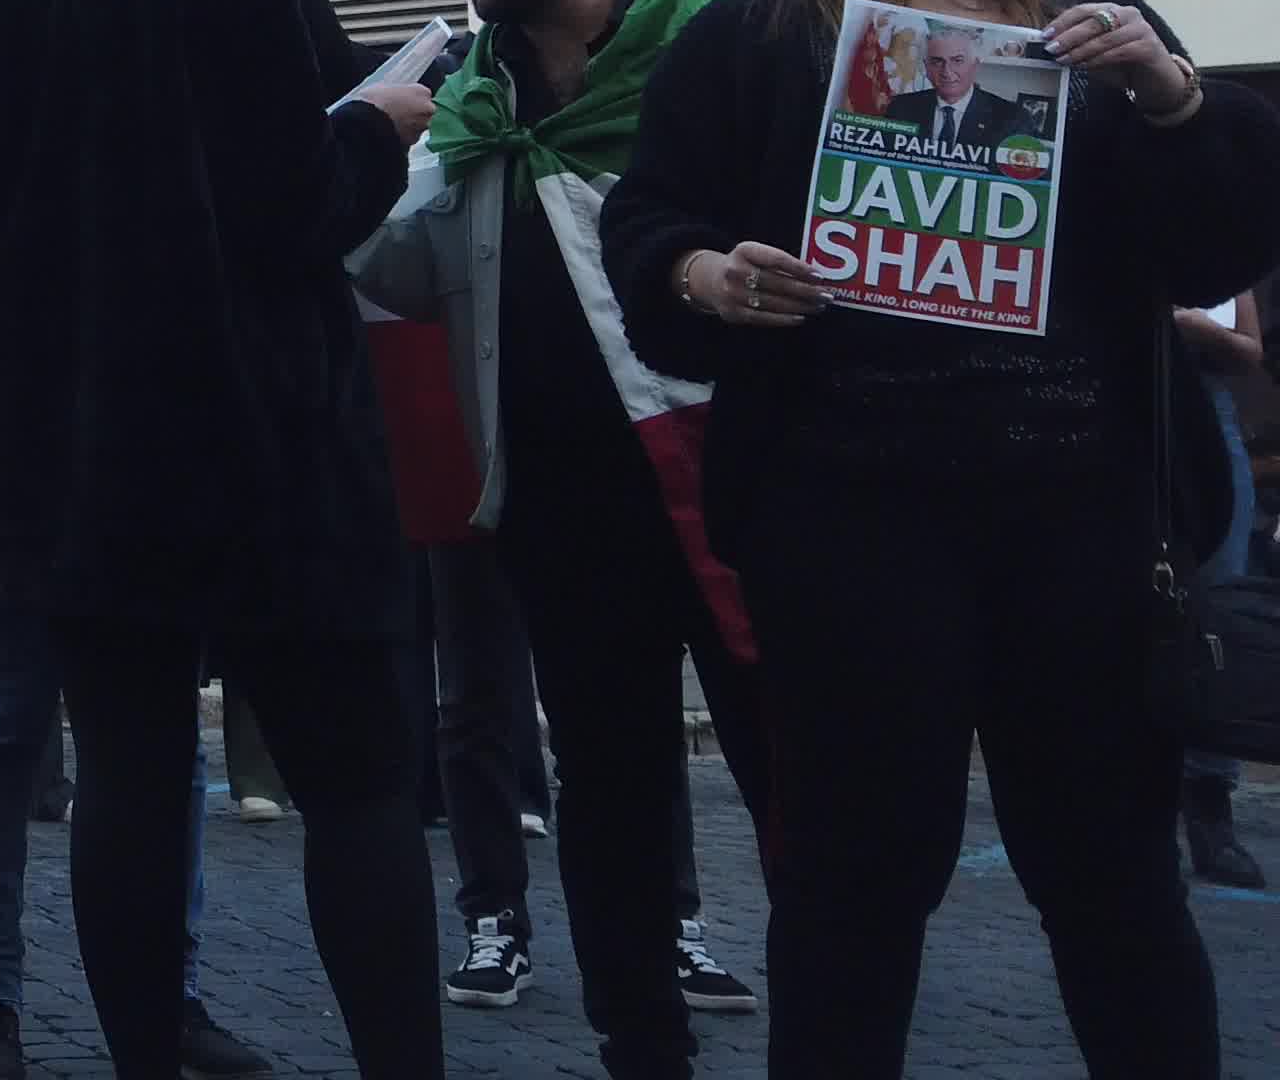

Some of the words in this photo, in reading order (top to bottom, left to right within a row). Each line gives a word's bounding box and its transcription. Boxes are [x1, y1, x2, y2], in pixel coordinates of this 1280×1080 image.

[830, 123, 885, 148] REZA
[893, 133, 990, 163] PAHLAVI
[819, 159, 1038, 240] JAVID
[810, 220, 1033, 308] SHAH
[863, 293, 899, 308] KING,
[902, 298, 938, 312] LONG
[940, 304, 969, 317] LIVE
[970, 308, 995, 321] THE
[996, 312, 1032, 325] KING
